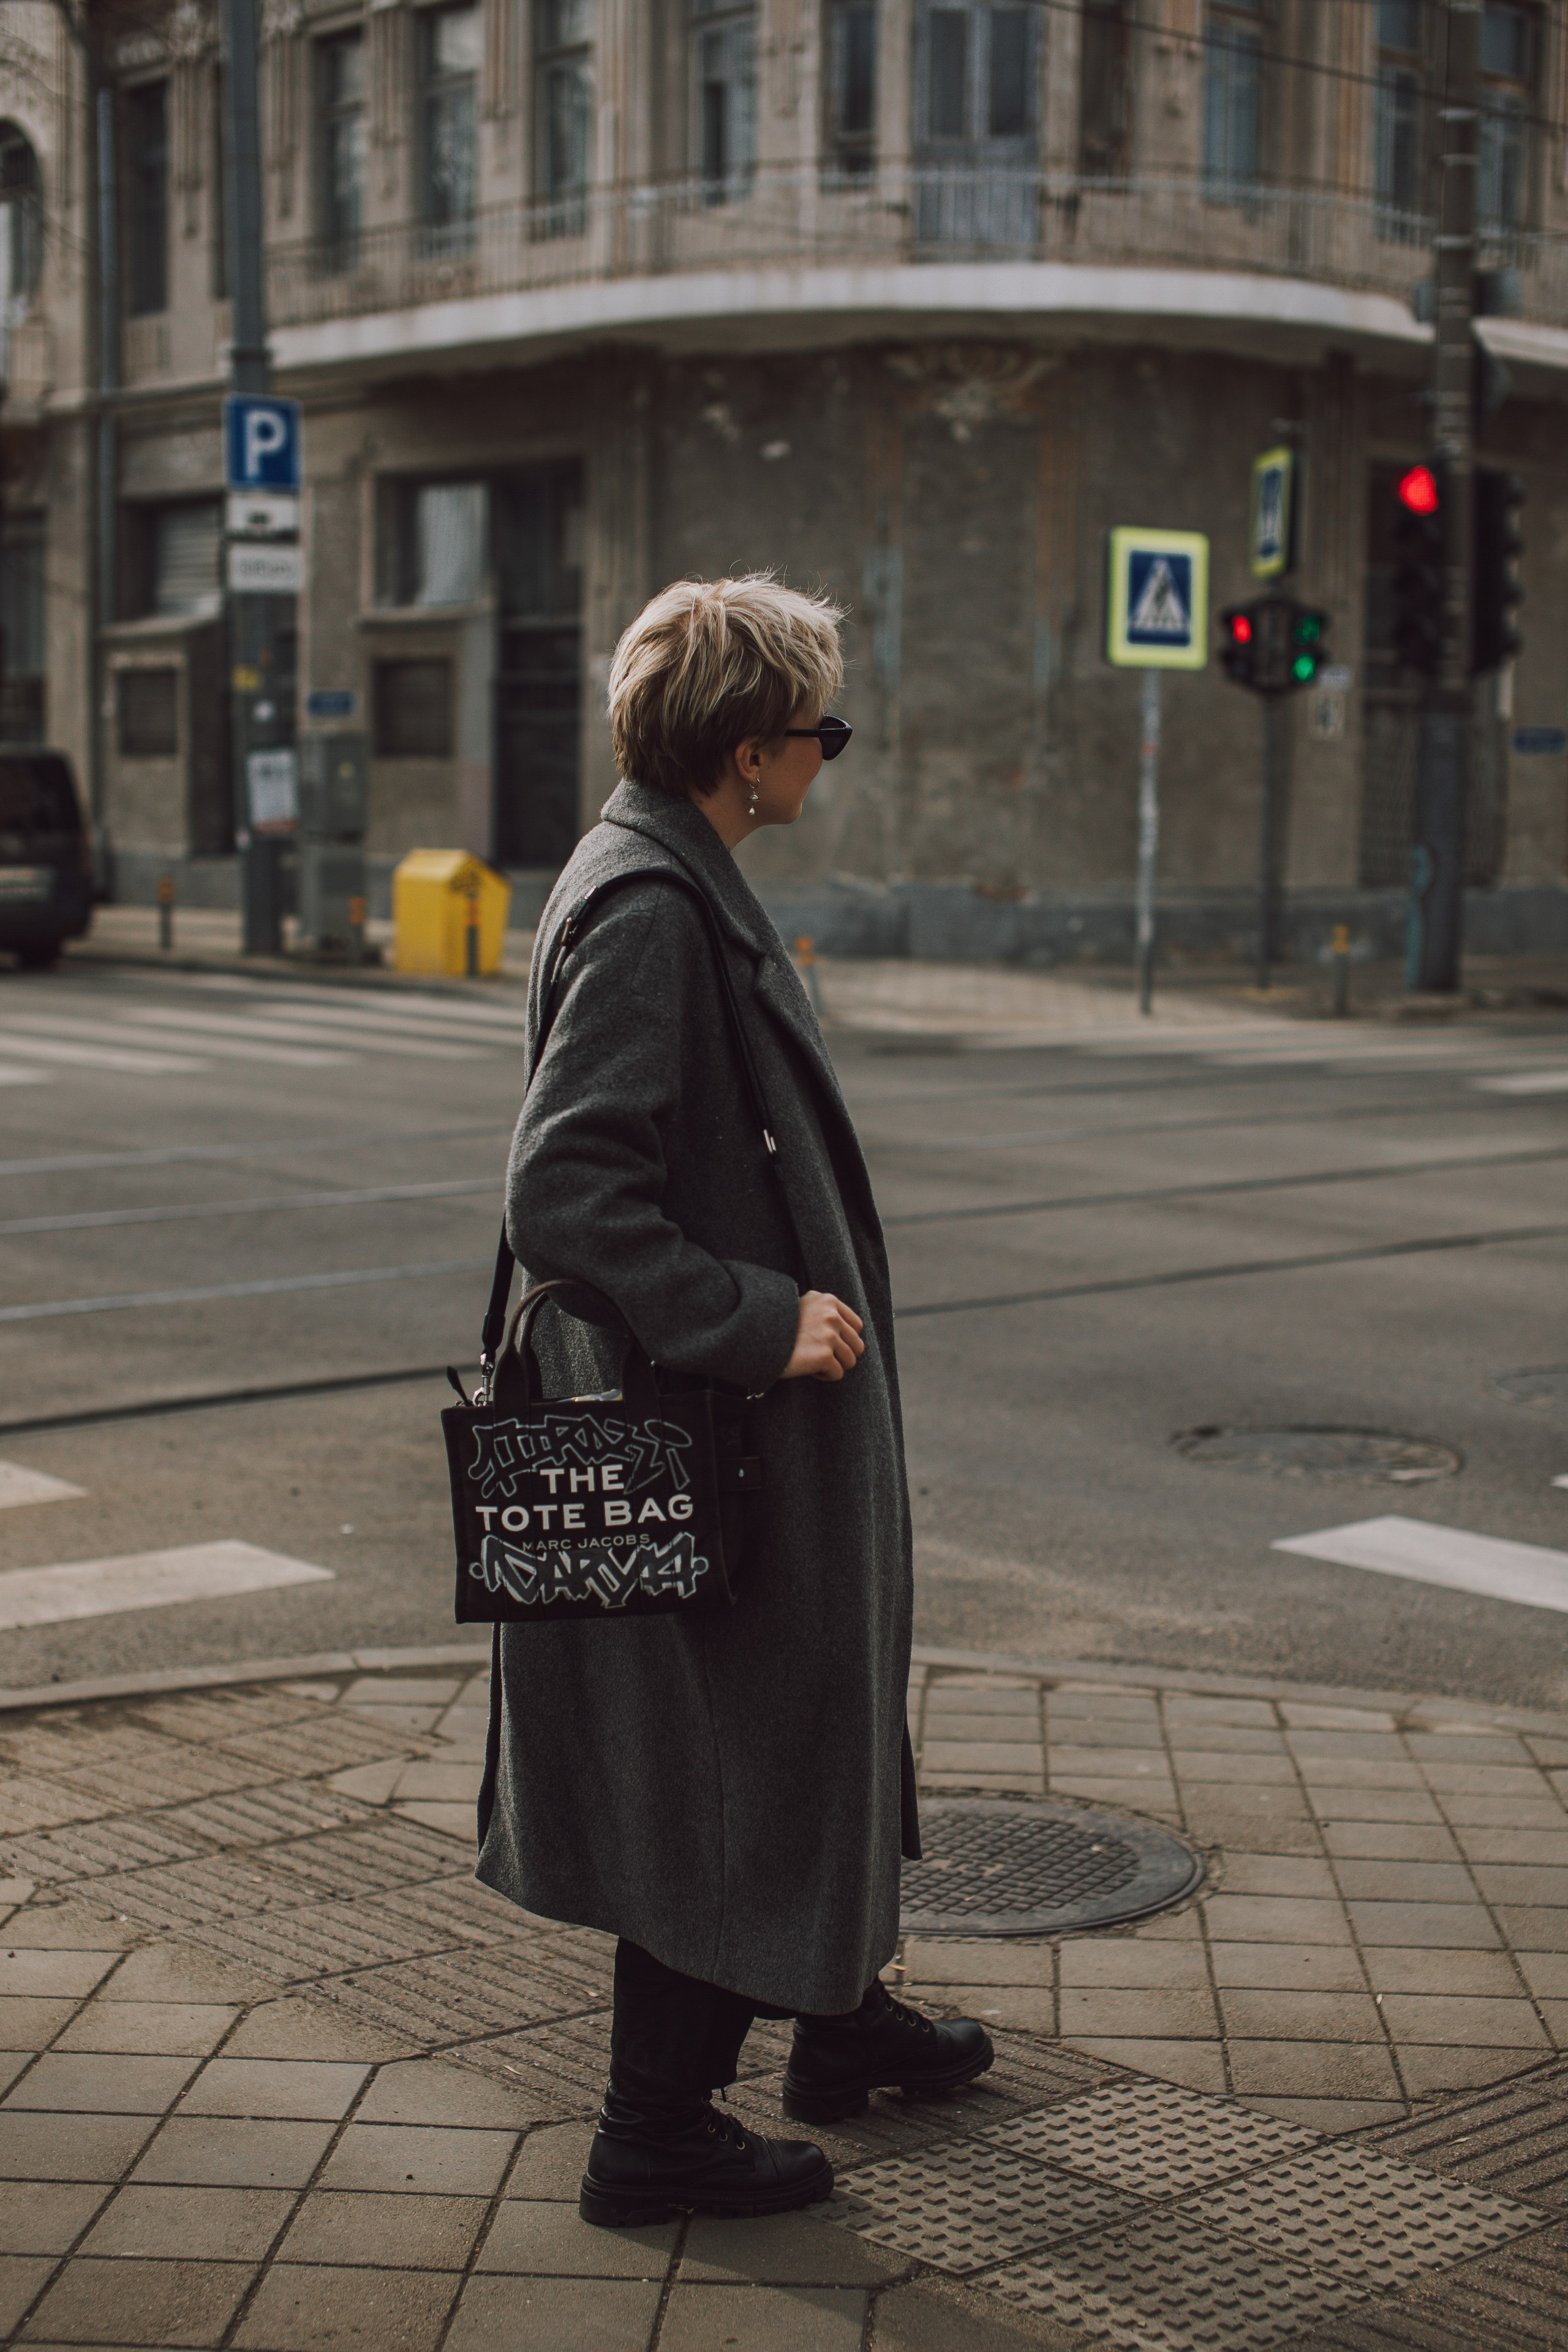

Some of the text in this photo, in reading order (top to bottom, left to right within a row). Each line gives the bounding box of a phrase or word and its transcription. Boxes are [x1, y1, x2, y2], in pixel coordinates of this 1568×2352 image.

[245, 411, 286, 477] P
[540, 1464, 624, 1494] THE
[475, 1494, 693, 1531] TOTE BAG
[522, 1534, 650, 1551] MARC JACOBS
